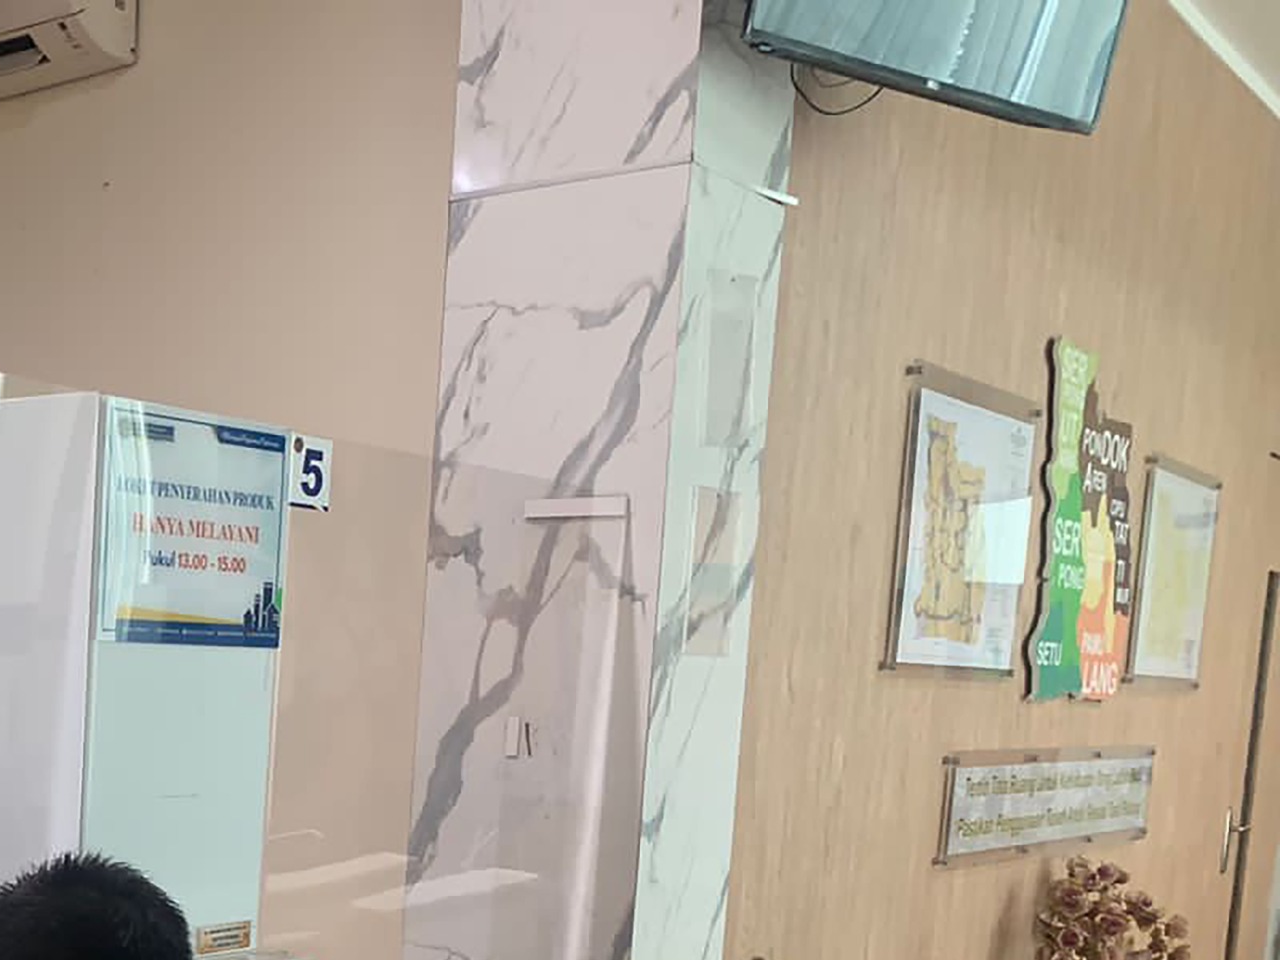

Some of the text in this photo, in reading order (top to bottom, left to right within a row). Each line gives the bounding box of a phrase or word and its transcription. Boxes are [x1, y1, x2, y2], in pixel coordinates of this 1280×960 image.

[300, 448, 324, 497] 5
[117, 476, 274, 510] LOKT PENYERAHAN PRODUK
[189, 518, 259, 544] MELAYANI
[1053, 518, 1081, 556] SER
[178, 552, 207, 571] 13.00
[218, 556, 246, 573] 15.00
[1037, 641, 1063, 667] SETU
